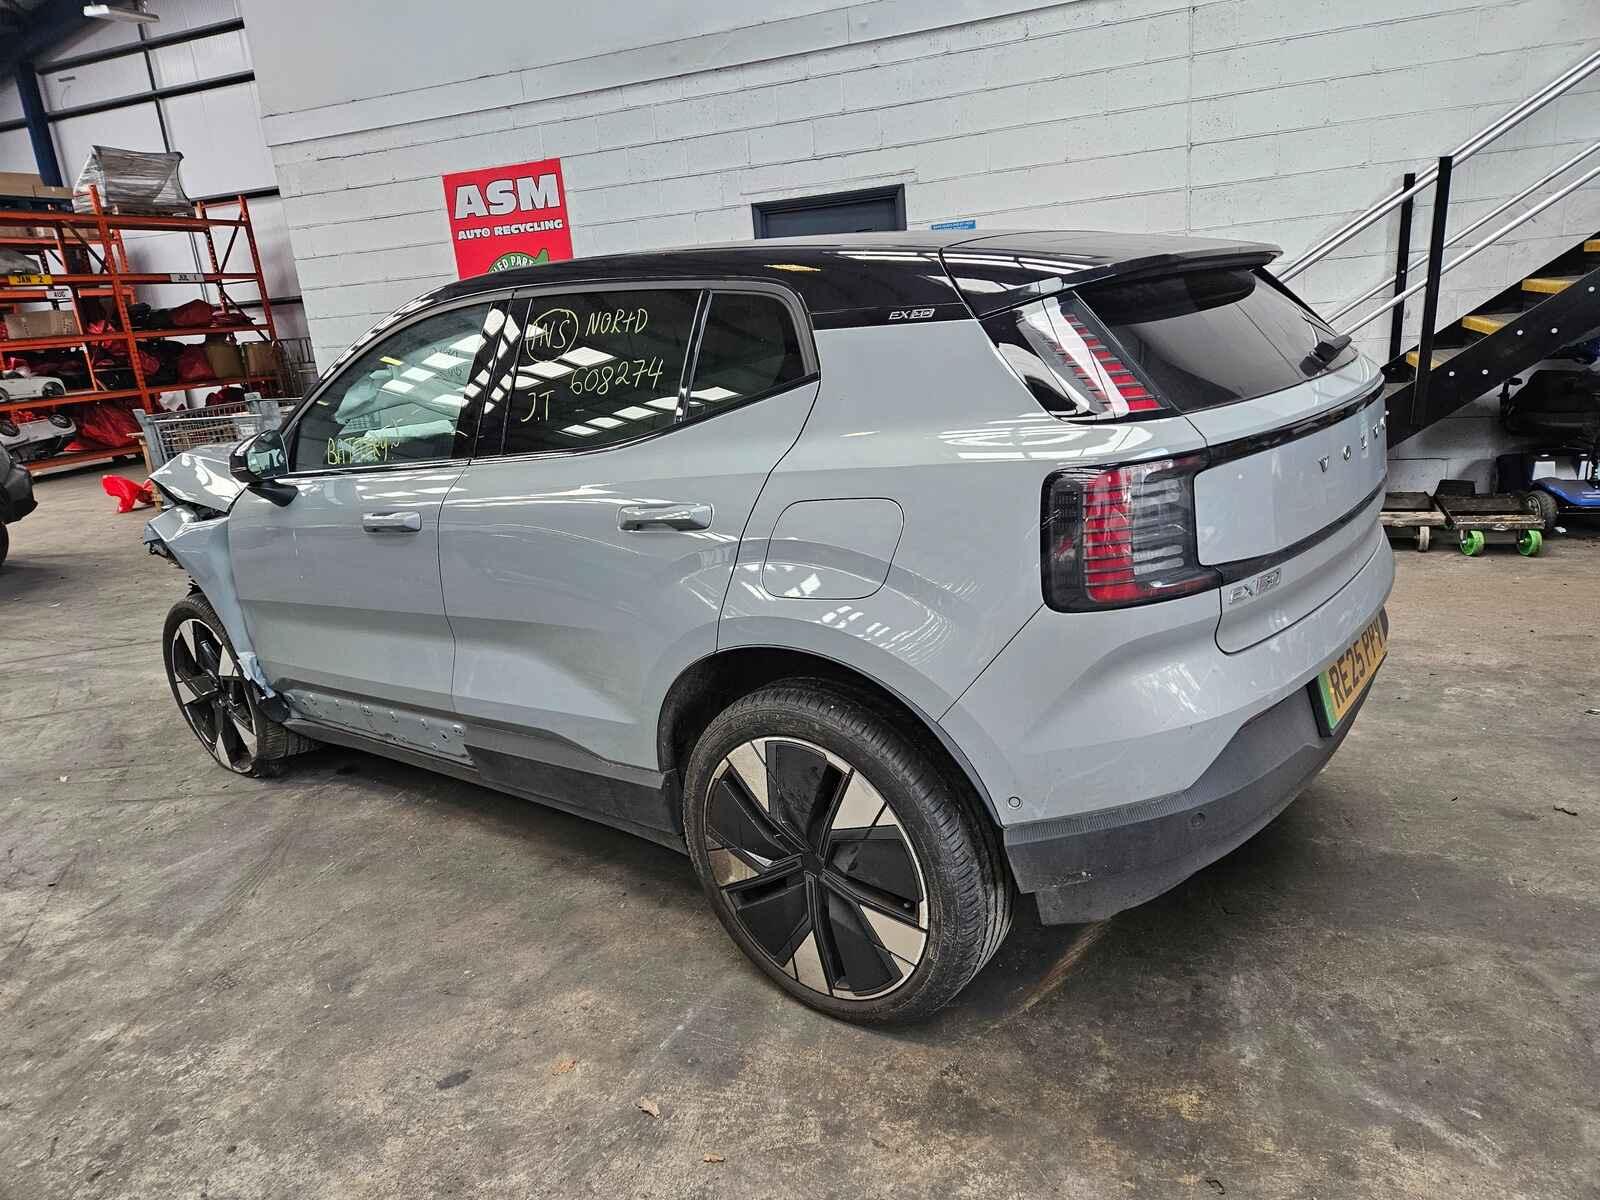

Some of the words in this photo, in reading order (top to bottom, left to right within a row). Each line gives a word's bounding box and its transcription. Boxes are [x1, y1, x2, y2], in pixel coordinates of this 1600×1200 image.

[454, 173, 561, 219] ASM
[457, 228, 491, 241] AUTO
[494, 219, 564, 236] RECYCLING
[569, 356, 664, 395] 608274
[1328, 639, 1366, 709] RE25
